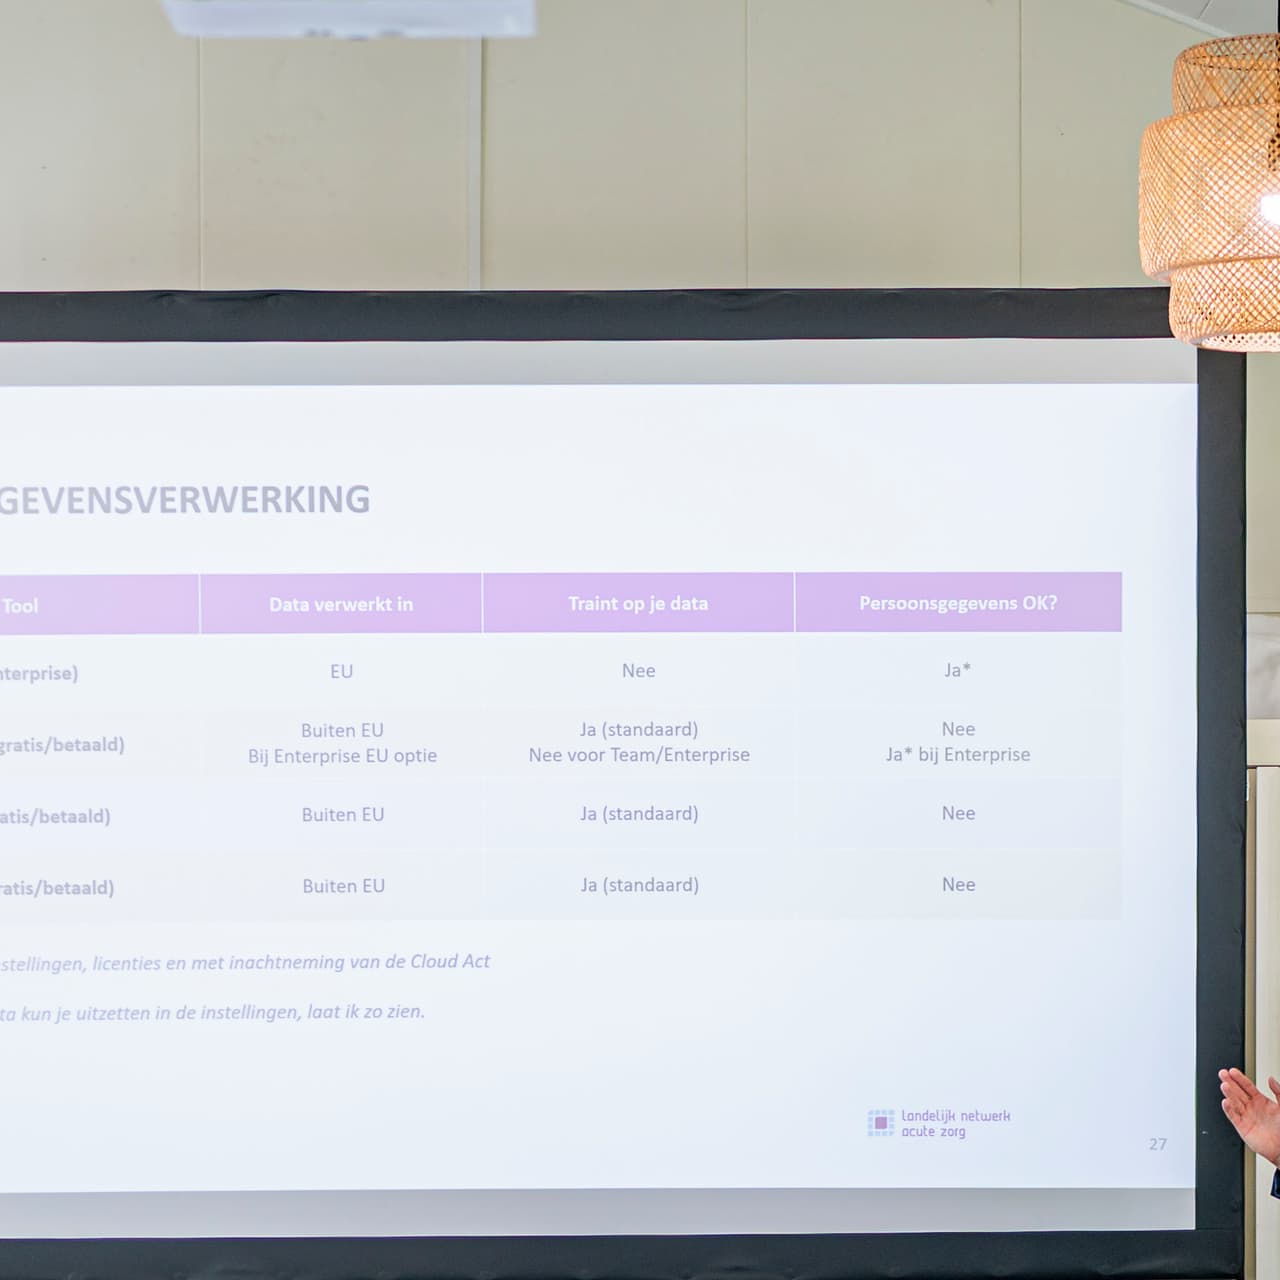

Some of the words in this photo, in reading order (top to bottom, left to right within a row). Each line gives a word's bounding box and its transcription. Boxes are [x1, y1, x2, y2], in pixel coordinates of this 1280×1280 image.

[1, 595, 39, 616] Tool
[269, 596, 310, 613] Data
[314, 595, 393, 613] verwerkt
[397, 595, 414, 612] in
[567, 594, 619, 612] Traint
[622, 599, 646, 615] op
[648, 594, 666, 615] je
[670, 594, 710, 612] data
[860, 595, 1019, 615] Persoonsgegevens
[1022, 593, 1059, 611] OK?
[330, 663, 353, 679] EU
[622, 663, 656, 679] Nee
[301, 722, 356, 739] Buiten
[361, 722, 384, 738] EU
[579, 721, 597, 737] Ja
[602, 720, 698, 741] (standaard)
[942, 721, 976, 737] Nee
[248, 748, 269, 768] Bij
[274, 748, 361, 767] Enterprise
[366, 747, 389, 764] EU
[393, 747, 438, 767] optie
[529, 747, 563, 763] Nee
[567, 750, 606, 763] voor
[610, 745, 751, 766] Team/Enterprise
[919, 745, 939, 766] bij
[944, 746, 1031, 766] Enterprise
[302, 807, 357, 823] Buiten
[362, 806, 385, 822] EU
[580, 805, 597, 822] Ja
[602, 804, 699, 825] (standaard)
[942, 805, 976, 821] Nee
[303, 878, 358, 894] Buiten
[362, 877, 385, 894] EU
[580, 876, 598, 893] Ja
[603, 876, 699, 897] (standaard)
[942, 876, 976, 892] Nee
[92, 955, 161, 971] licenties
[165, 959, 187, 971] en
[191, 956, 225, 971] met
[228, 953, 345, 973] inachtneming
[350, 957, 381, 969] van
[384, 952, 407, 969] de
[410, 952, 459, 969] Cloud
[461, 952, 491, 969] Act
[21, 1005, 52, 1022] kun
[54, 1006, 72, 1025] je
[76, 1005, 151, 1022] uitzetten
[155, 1005, 171, 1021] in
[175, 1003, 197, 1021] de
[200, 1003, 302, 1024] instellingen,
[306, 1002, 342, 1020] laat
[345, 1003, 361, 1020] ik
[363, 1007, 383, 1020] zo
[386, 1003, 425, 1019] zien.
[901, 1109, 956, 1125] landelijk
[960, 1109, 1011, 1122] netwerk
[901, 1125, 936, 1137] acute
[940, 1127, 966, 1140] zorg
[1149, 1137, 1168, 1151] 27
